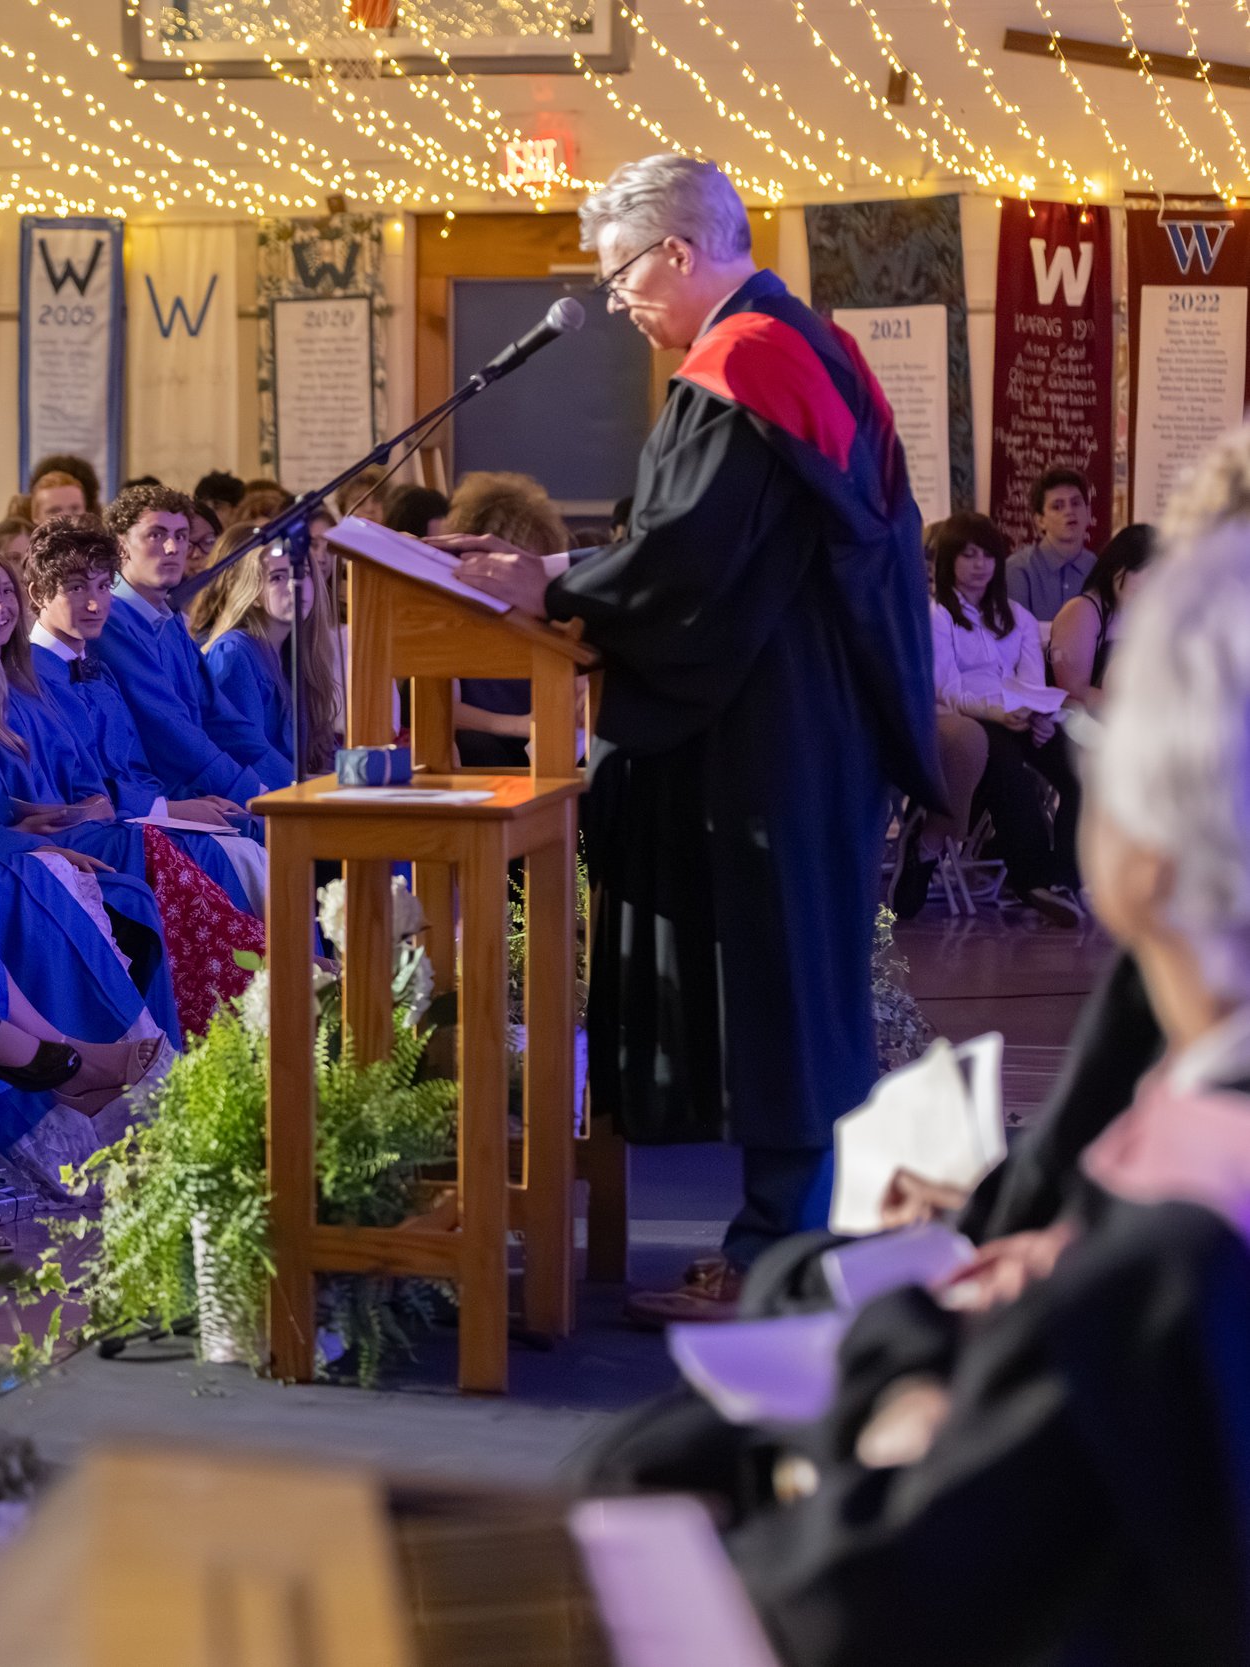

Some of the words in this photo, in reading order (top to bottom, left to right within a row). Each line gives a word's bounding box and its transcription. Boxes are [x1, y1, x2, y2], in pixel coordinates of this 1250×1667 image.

[37, 238, 104, 297] W
[291, 241, 361, 289] W
[1028, 237, 1094, 307] W
[1157, 219, 1236, 275] W
[144, 273, 219, 338] W
[302, 308, 356, 329] 2020
[1167, 292, 1220, 313] 2022
[869, 320, 913, 341] 2021
